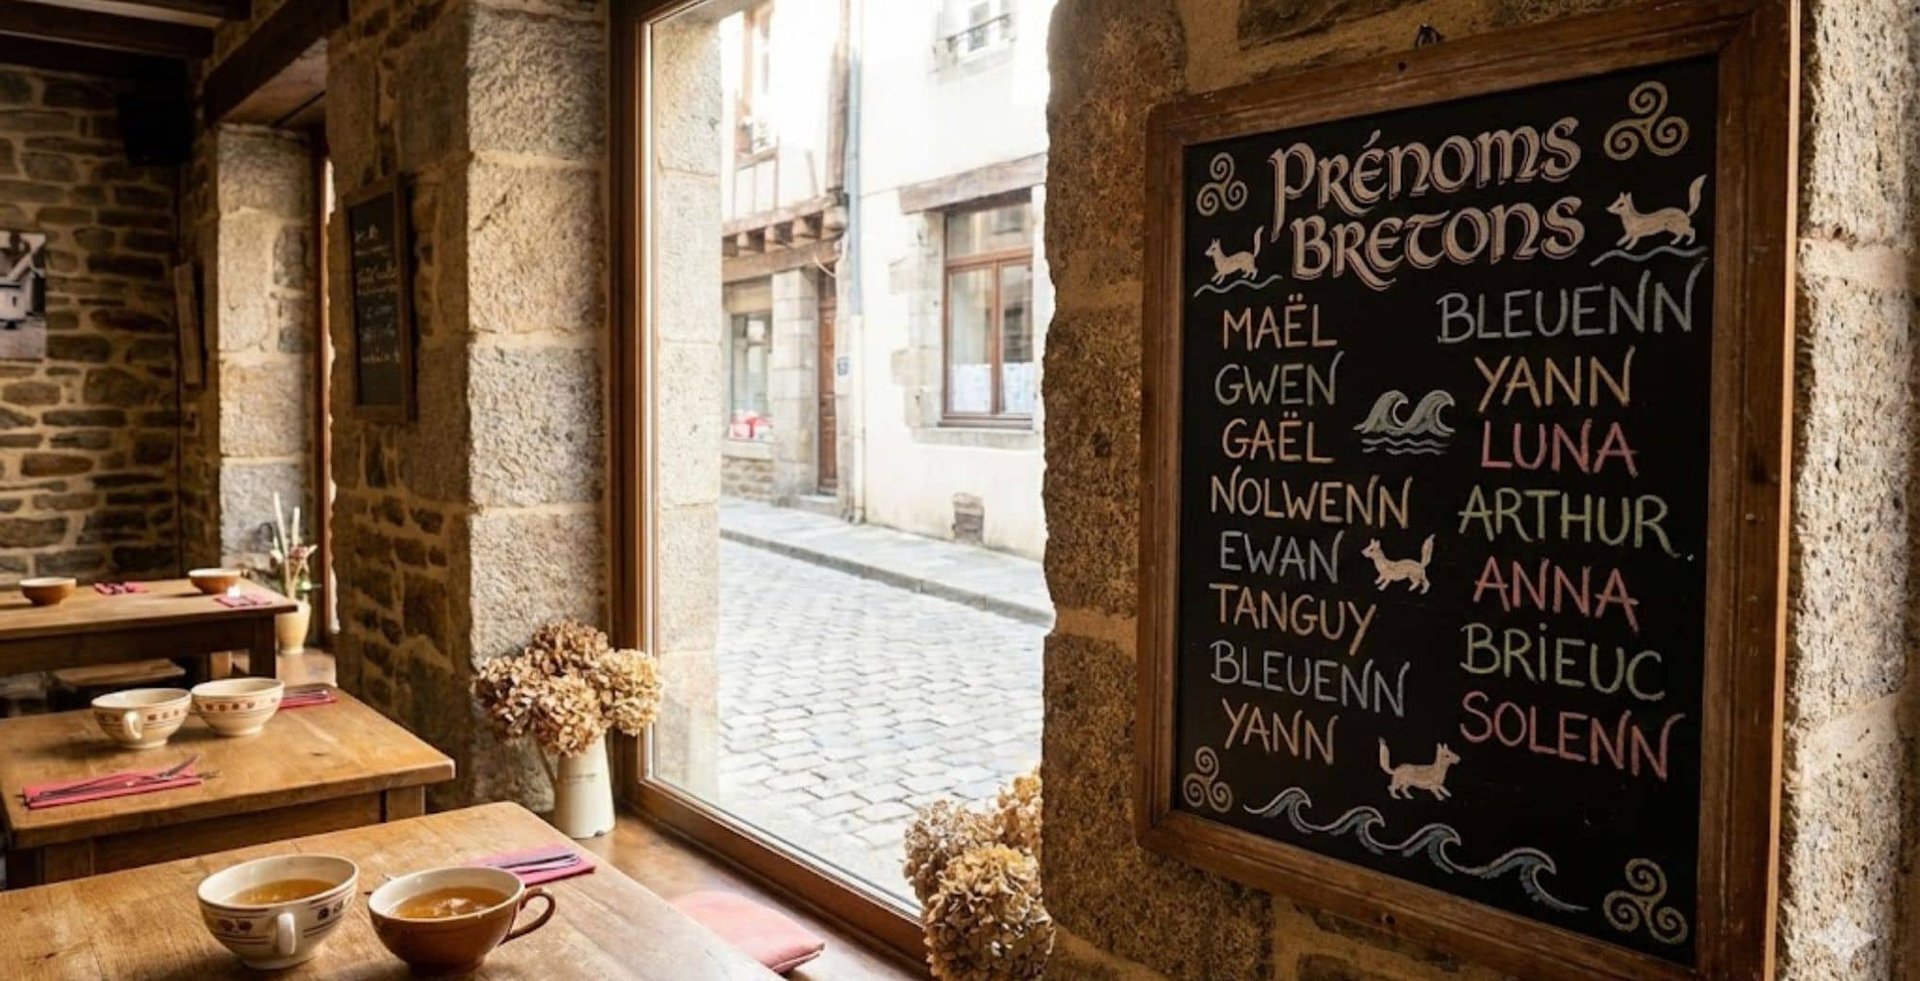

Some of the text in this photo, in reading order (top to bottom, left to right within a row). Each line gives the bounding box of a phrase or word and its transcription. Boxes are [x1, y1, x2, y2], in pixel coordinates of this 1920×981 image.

[1222, 294, 1338, 351] MAËL
[1437, 257, 1709, 344] BLEUENN
[1214, 351, 1345, 406] GWEN
[1474, 347, 1636, 413] YANN
[1221, 412, 1335, 465] GAËL
[1480, 418, 1638, 477] LUNA
[1210, 465, 1413, 529] NOLWENN
[1458, 485, 1682, 558] ARTHUR
[1219, 530, 1344, 584] EWAN
[1208, 583, 1377, 656] TANGUY
[1473, 556, 1639, 632] ANNA
[1209, 640, 1411, 716] BLEUENN
[1221, 698, 1340, 765] YANN
[1459, 690, 1686, 781] SOLENN
